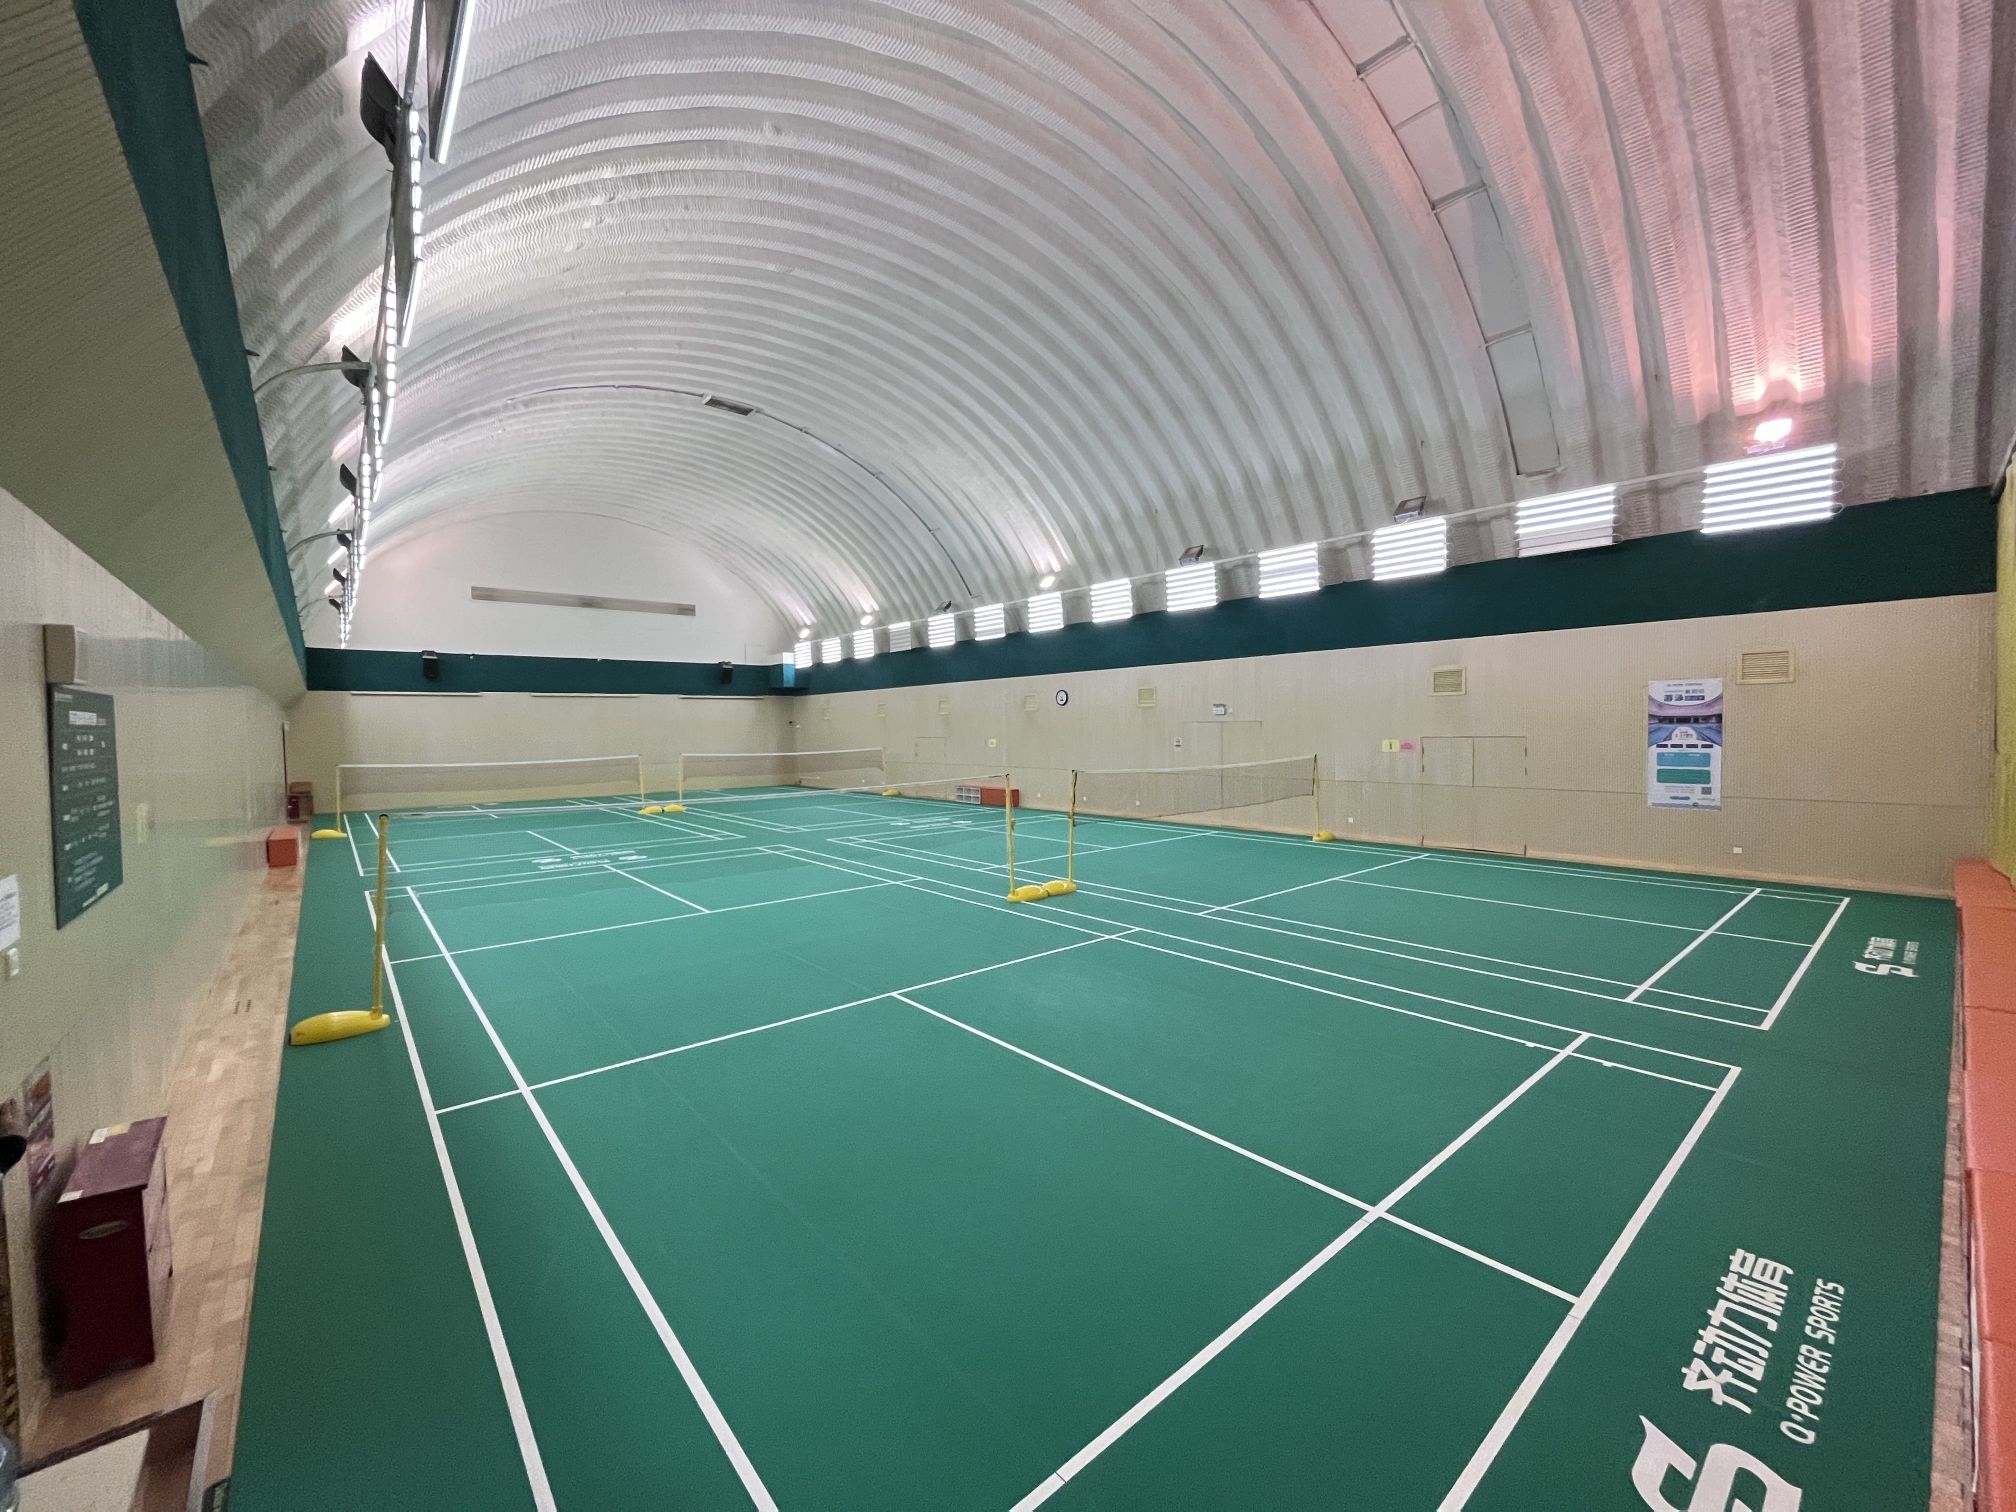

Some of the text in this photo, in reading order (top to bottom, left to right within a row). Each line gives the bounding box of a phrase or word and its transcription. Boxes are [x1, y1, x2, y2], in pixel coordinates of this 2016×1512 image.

[1680, 1248, 1794, 1415] 齐动力体育
[1804, 1278, 1845, 1345] SPORTS
